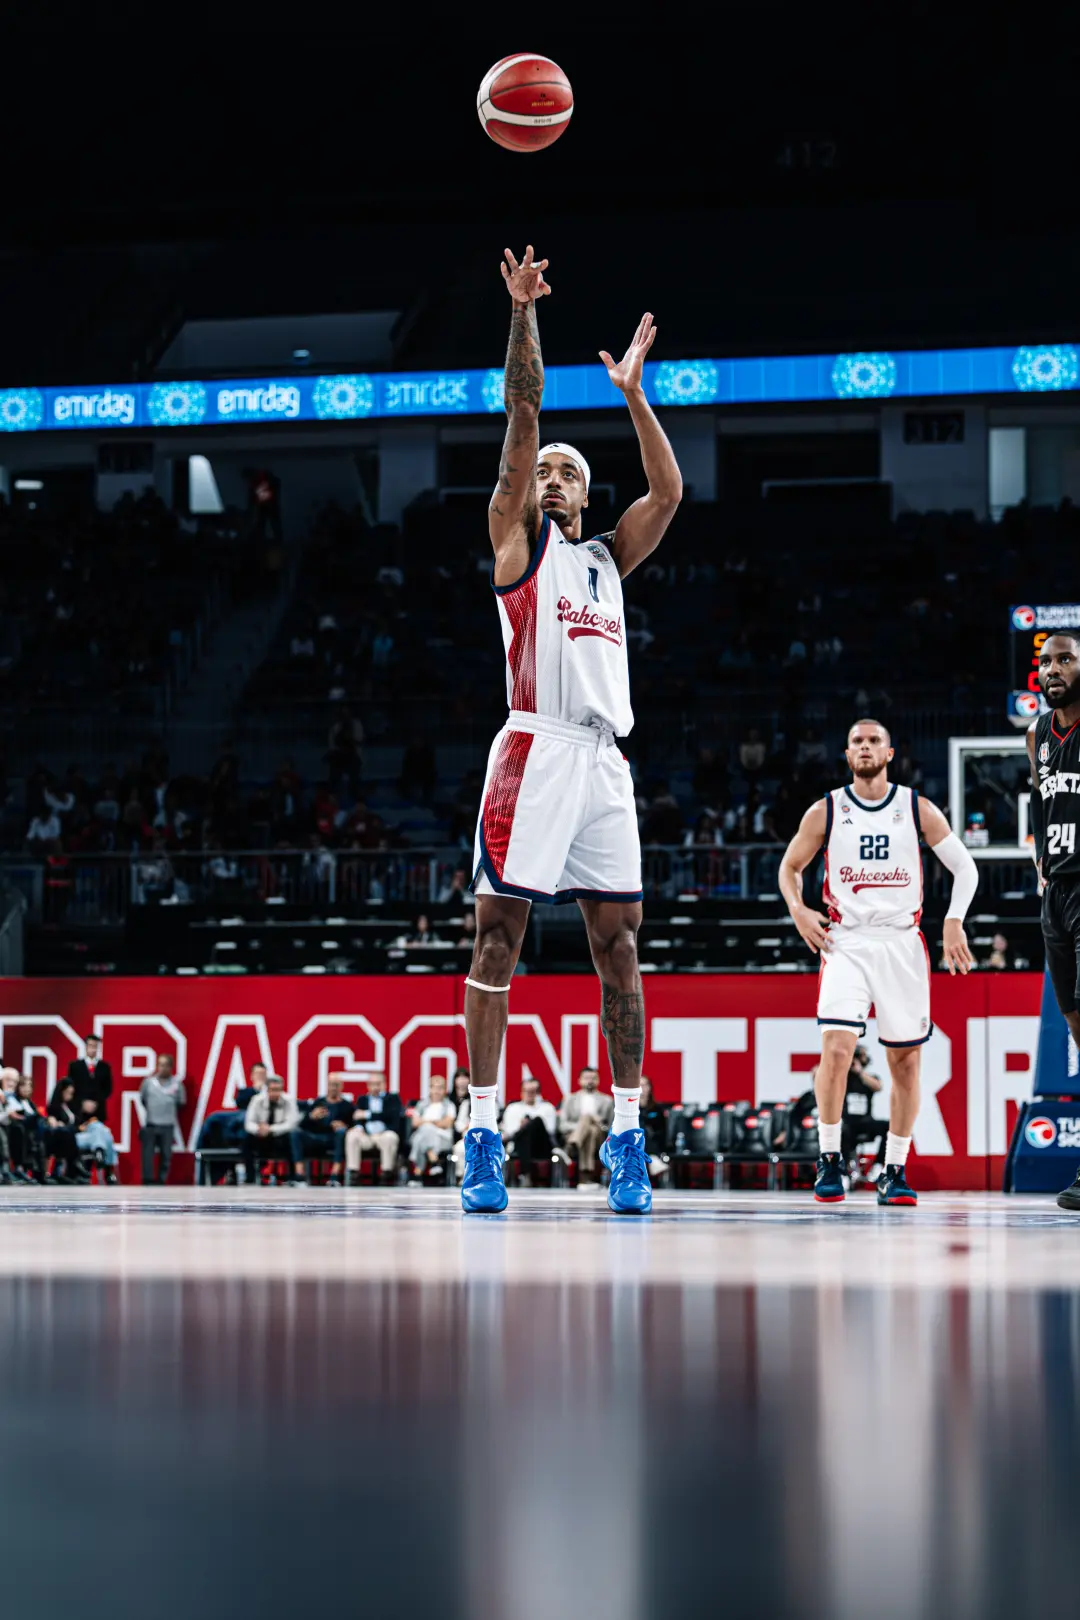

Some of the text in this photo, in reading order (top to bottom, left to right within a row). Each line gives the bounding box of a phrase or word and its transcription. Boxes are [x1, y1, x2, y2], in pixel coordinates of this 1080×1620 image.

[859, 834, 889, 860] 22
[1047, 823, 1076, 855] 24
[1, 1014, 600, 1154] DRAGON
